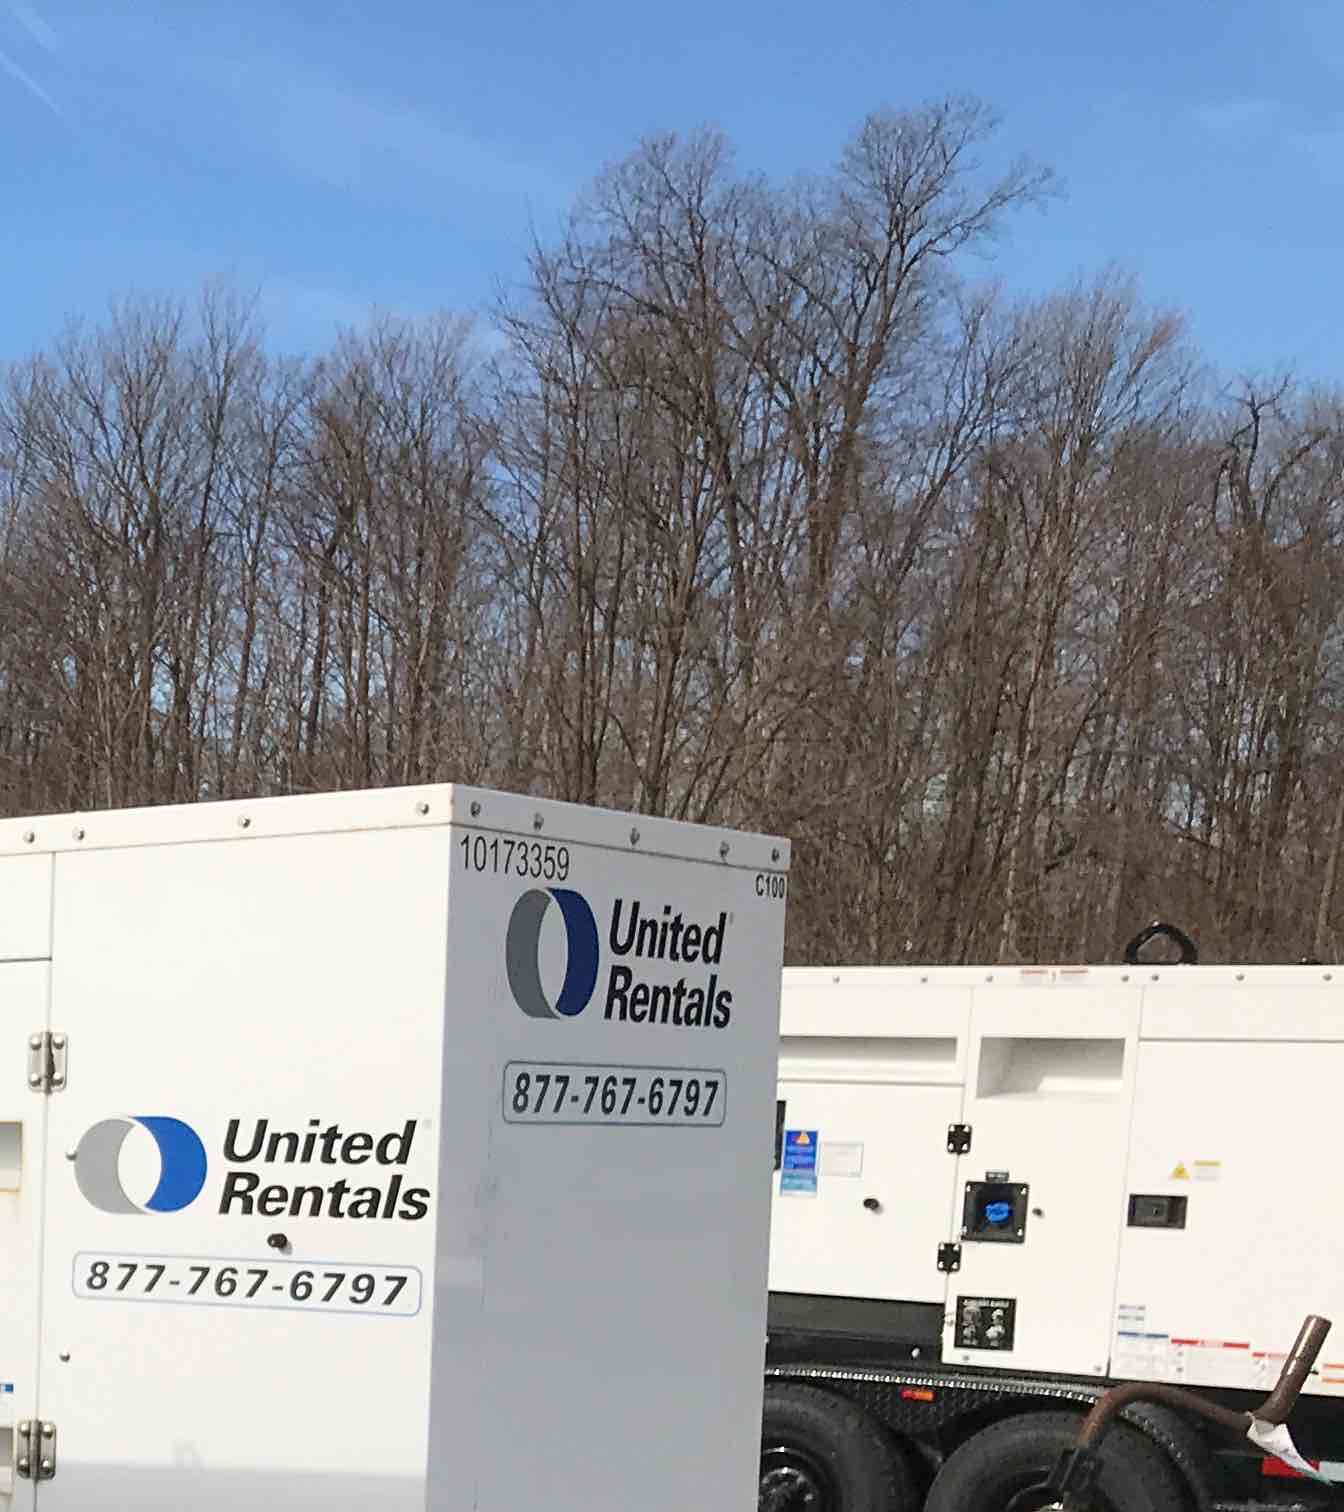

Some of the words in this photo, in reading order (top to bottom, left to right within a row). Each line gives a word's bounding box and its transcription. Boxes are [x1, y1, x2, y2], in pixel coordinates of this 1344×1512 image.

[460, 834, 570, 881] 10173359
[608, 898, 728, 965] United
[603, 964, 733, 1029] Rentals
[511, 1071, 720, 1117] 877-767-6797
[221, 1119, 418, 1165] United
[218, 1171, 431, 1221] Rentals
[85, 1260, 409, 1307] 877-767-6797
